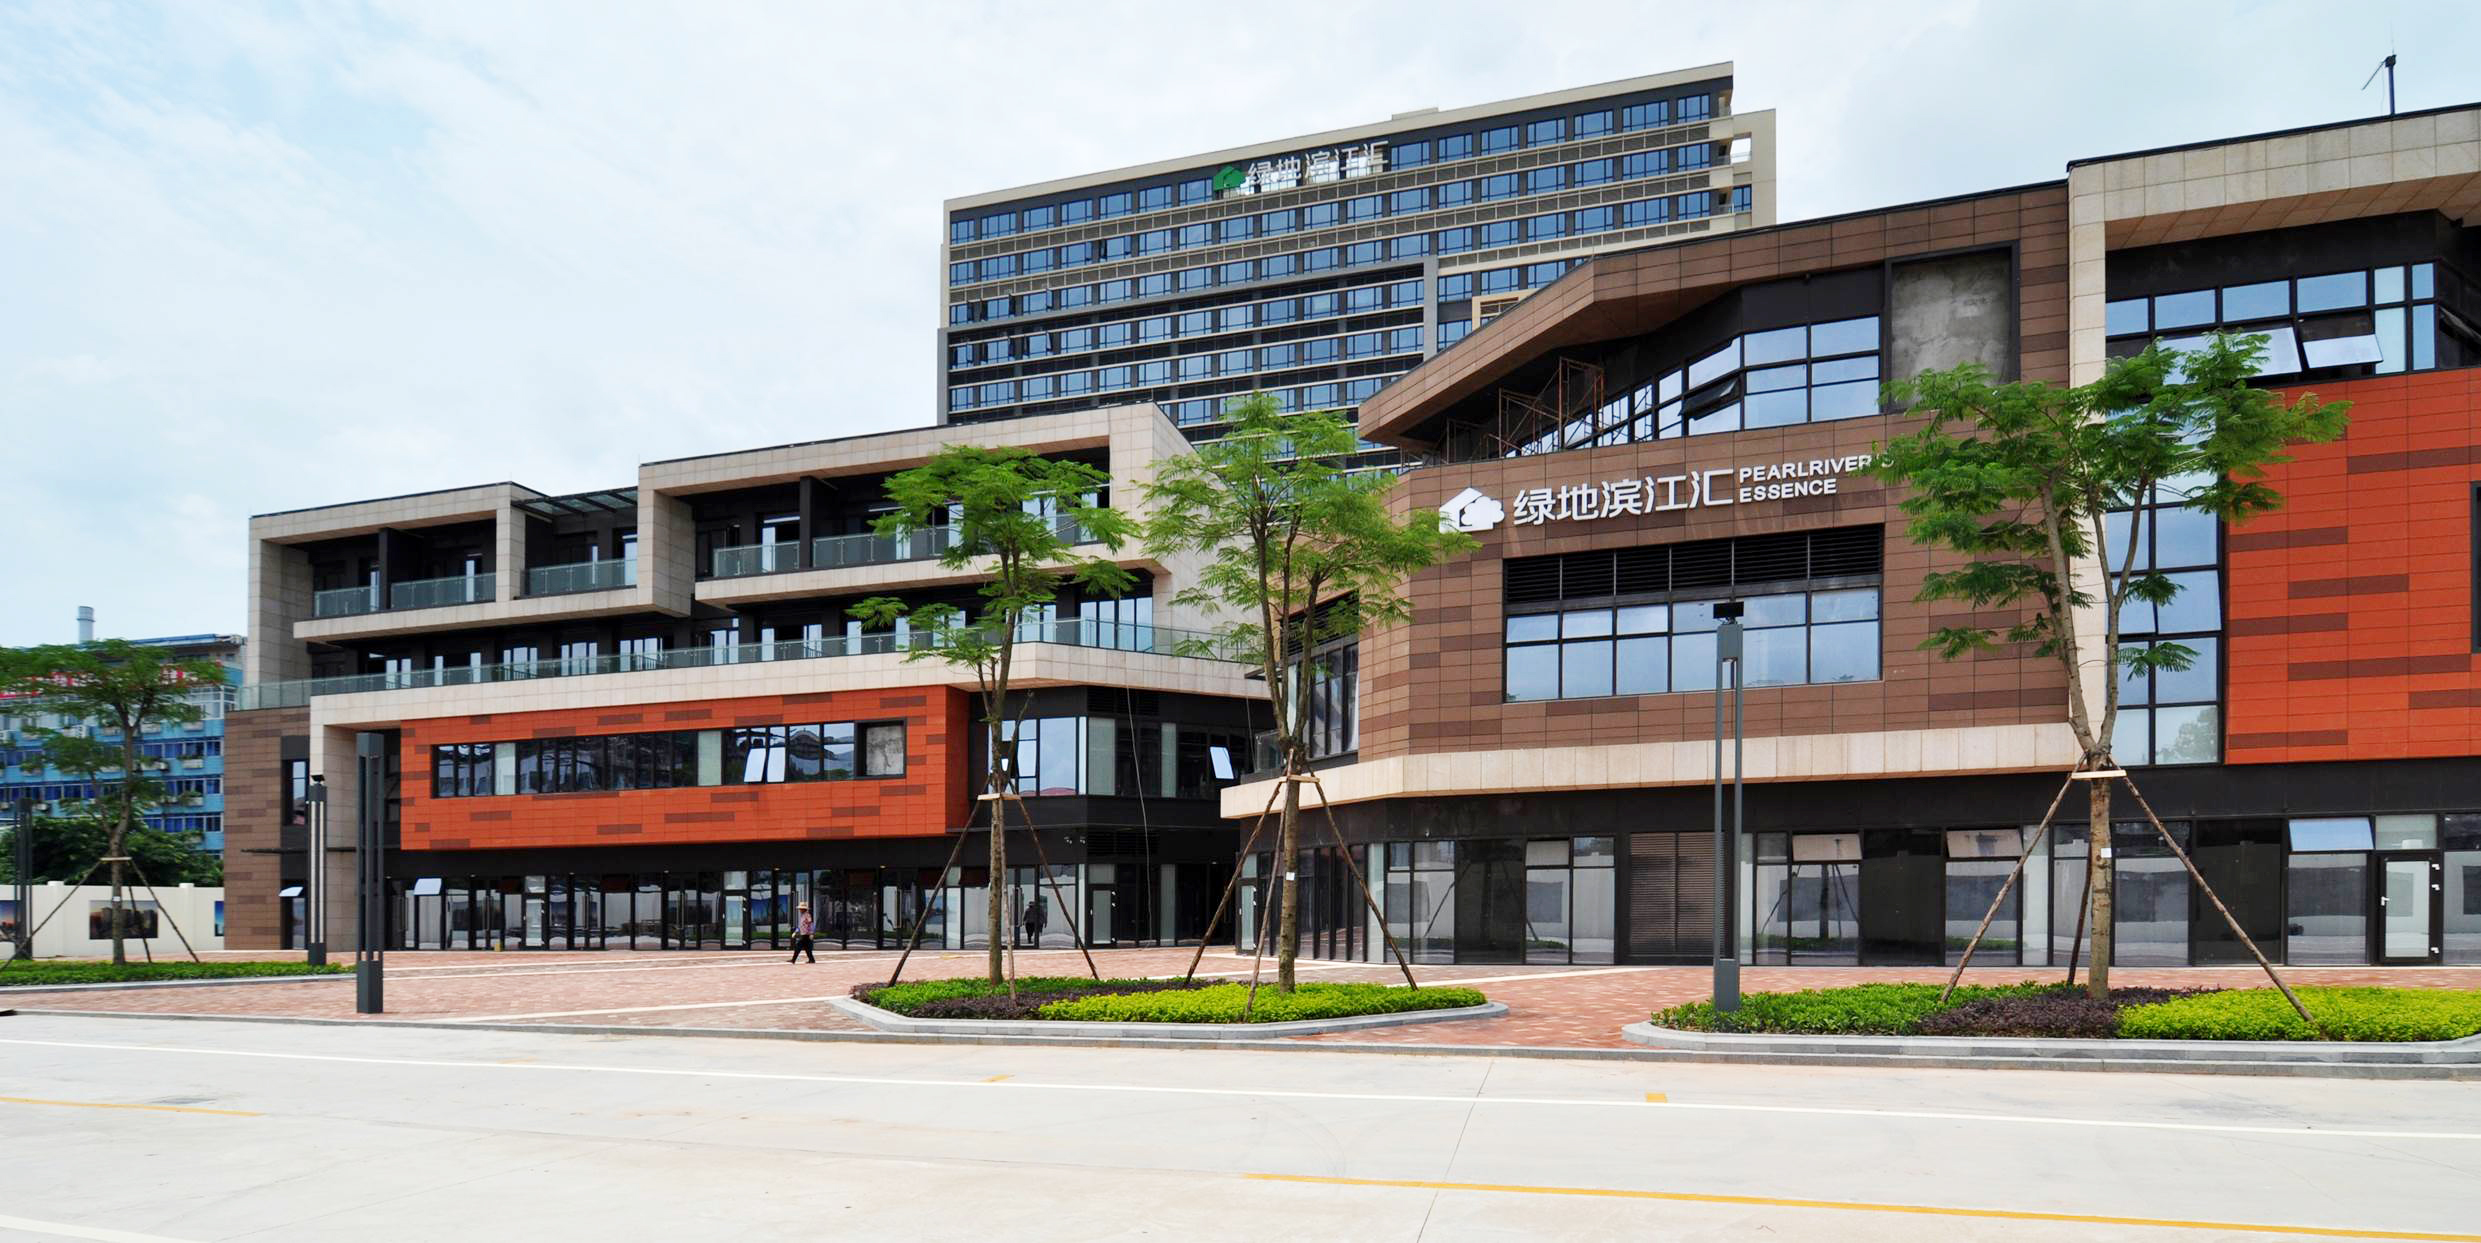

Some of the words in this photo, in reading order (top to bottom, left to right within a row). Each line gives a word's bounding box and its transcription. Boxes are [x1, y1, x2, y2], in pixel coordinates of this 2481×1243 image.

[1247, 141, 1389, 185] 绿地滨江汇
[1513, 468, 1734, 525] 绿地滨江汇
[1739, 478, 1837, 503] ESSENCE
